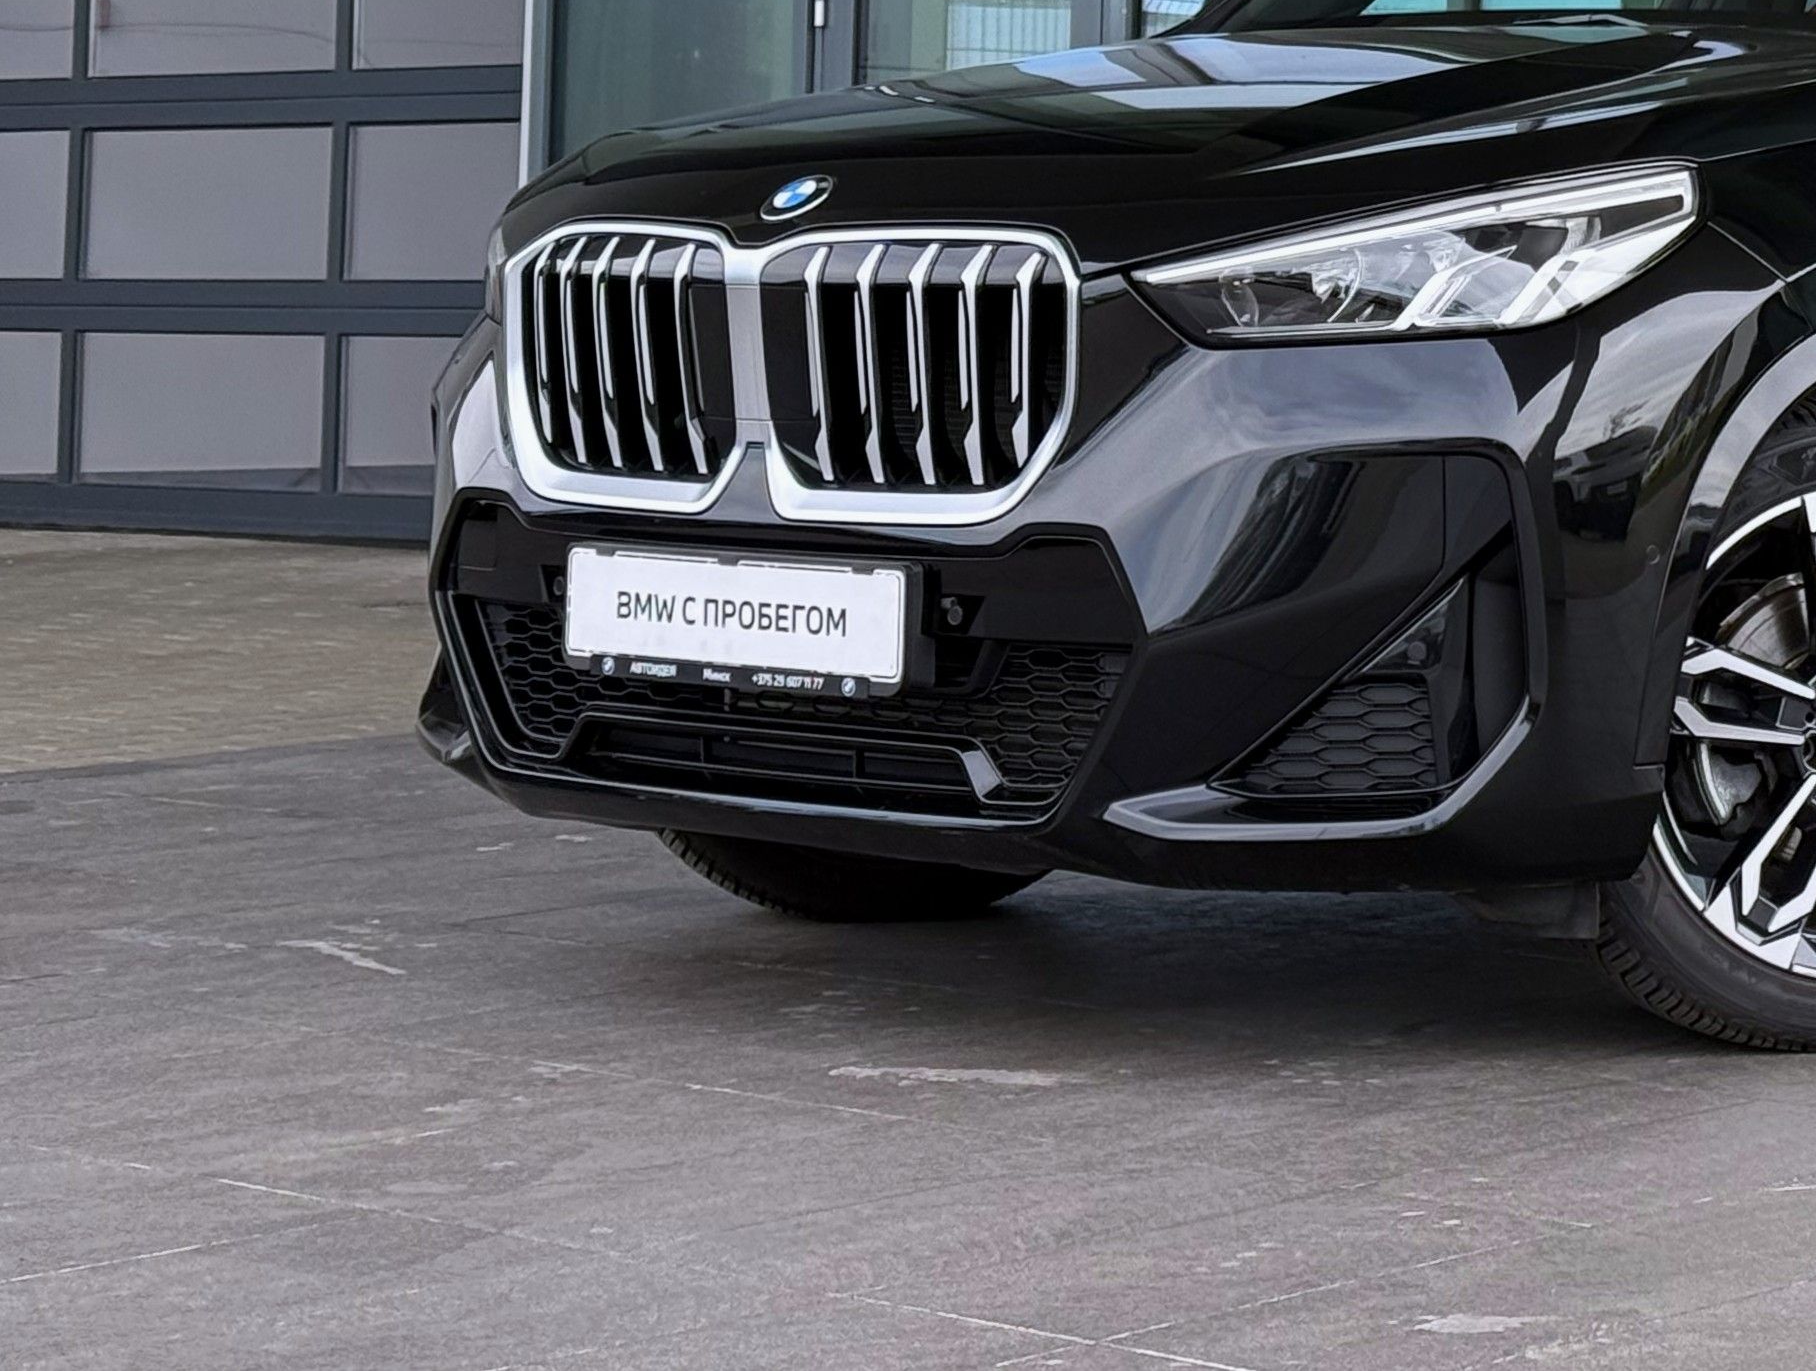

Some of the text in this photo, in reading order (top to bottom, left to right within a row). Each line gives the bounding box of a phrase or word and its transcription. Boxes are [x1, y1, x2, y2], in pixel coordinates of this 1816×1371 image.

[616, 591, 847, 637] BMW С ПРОБЕГОМ
[703, 668, 731, 682] Минск
